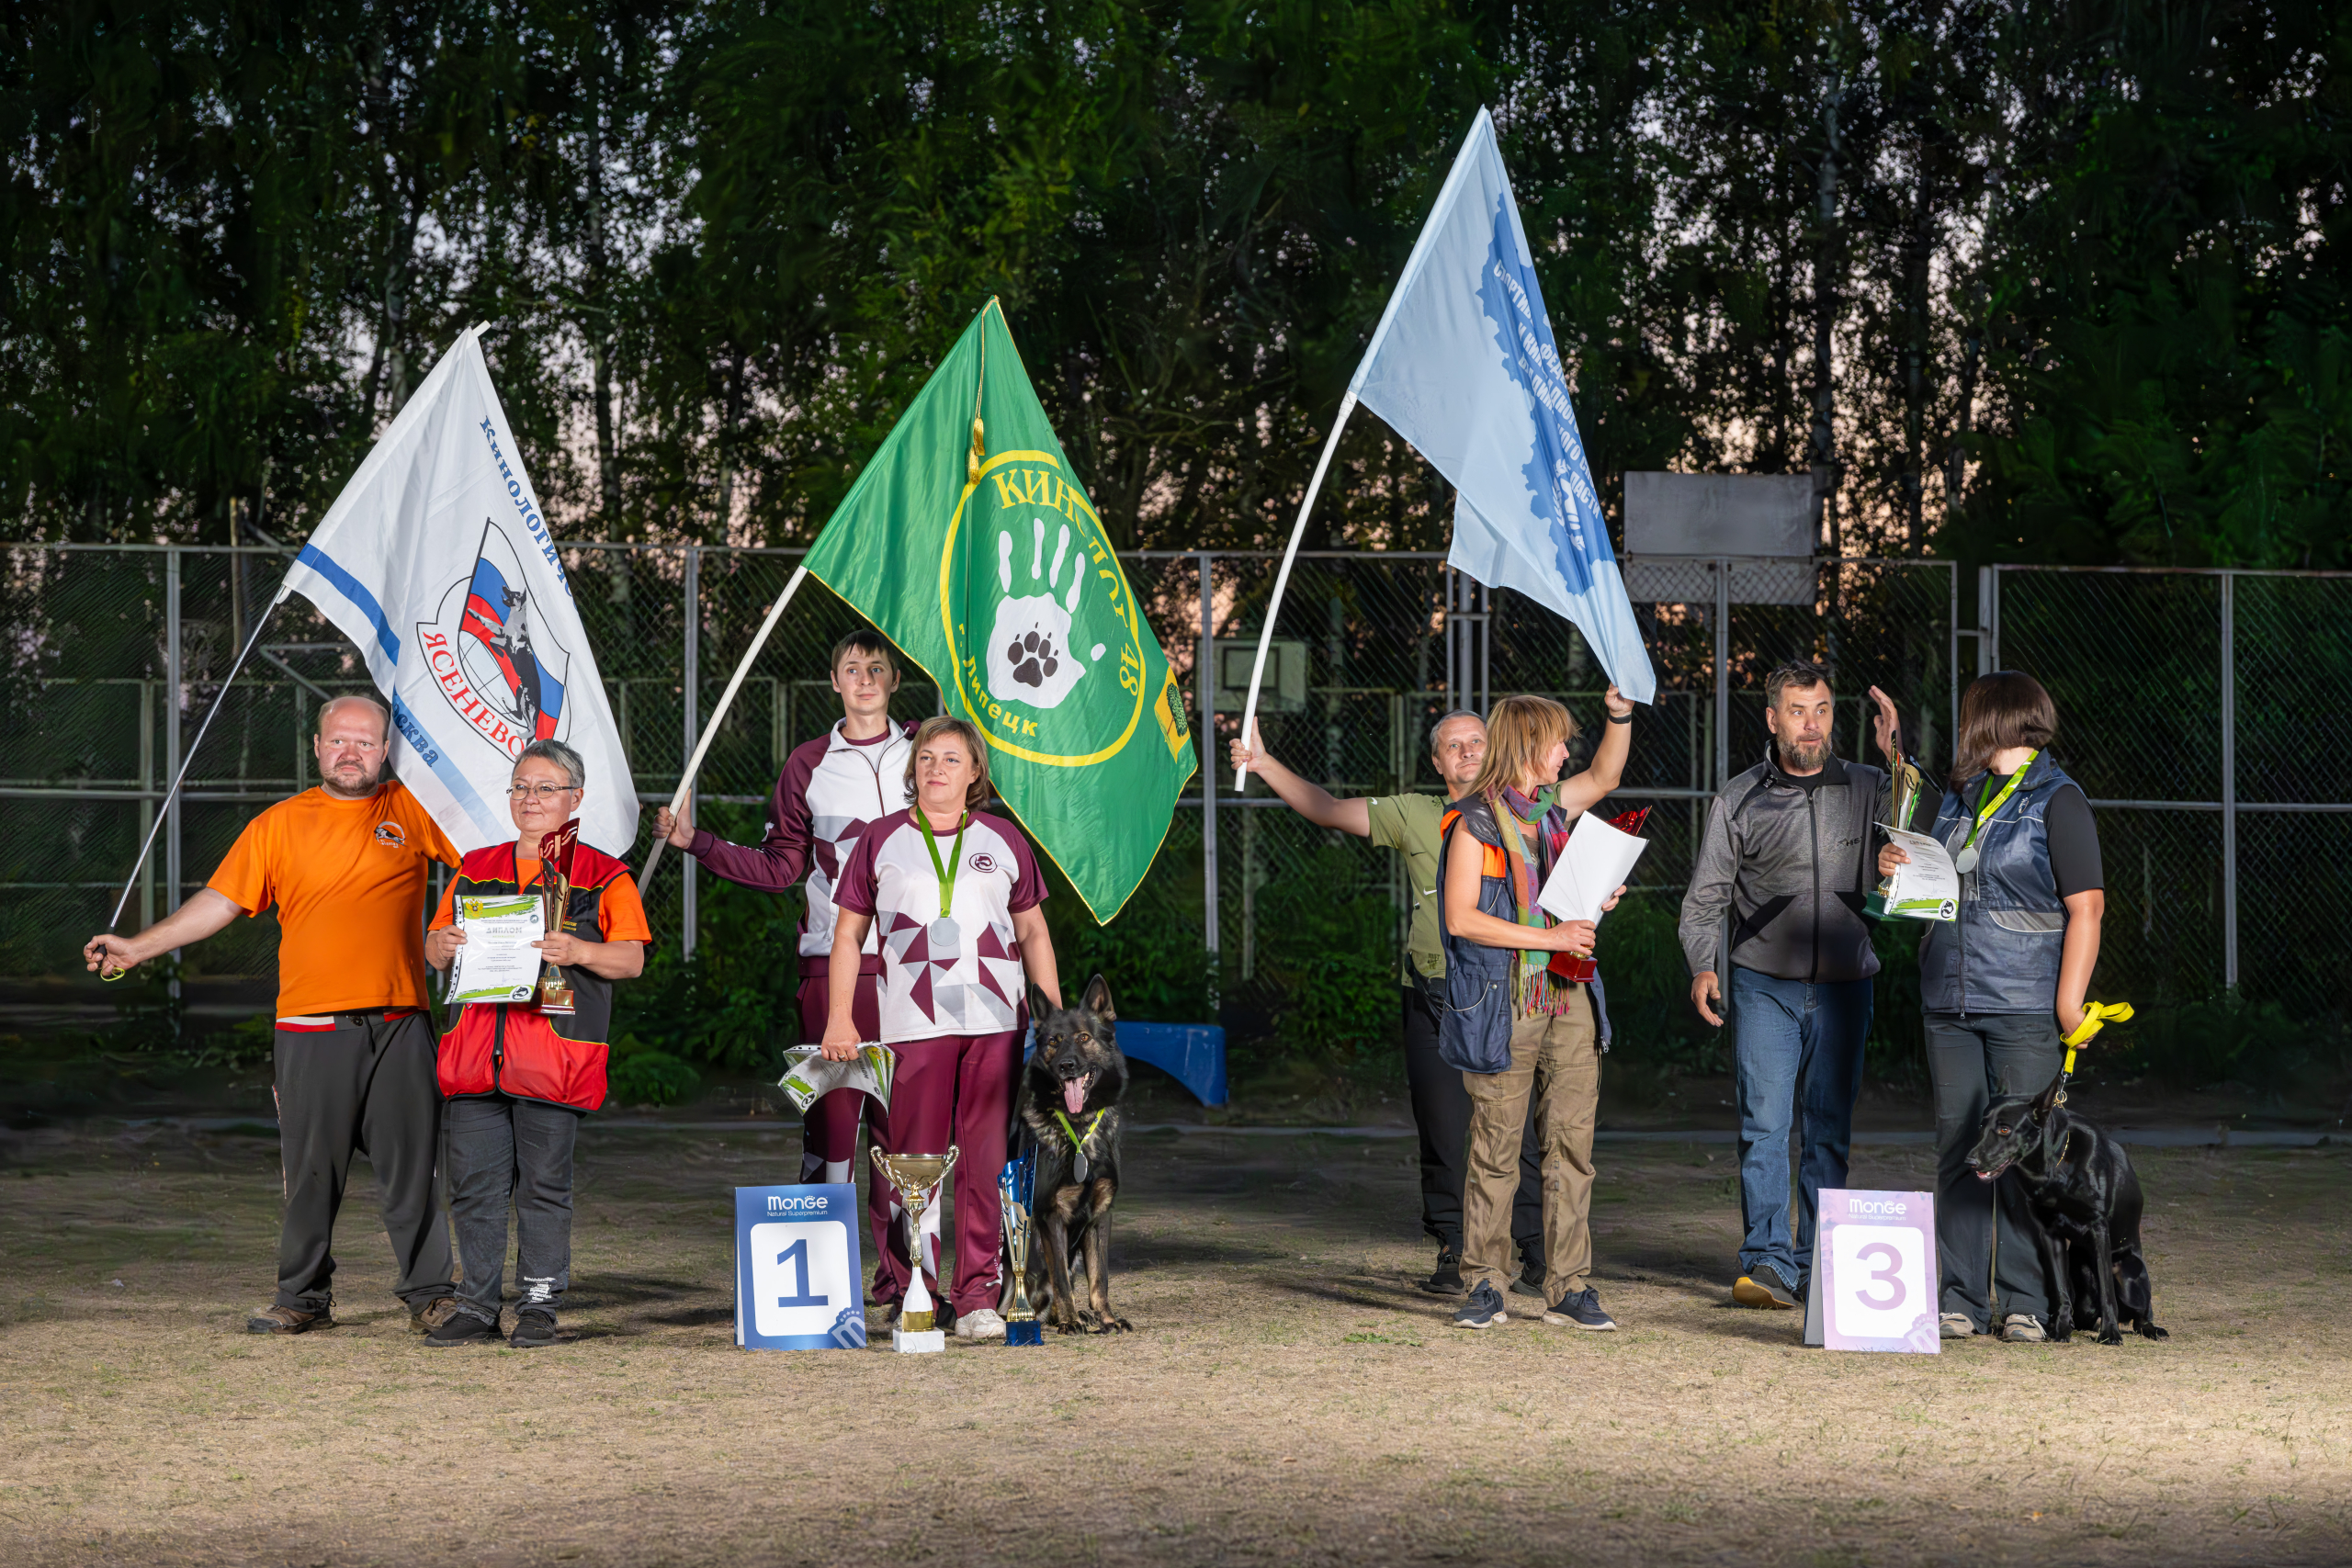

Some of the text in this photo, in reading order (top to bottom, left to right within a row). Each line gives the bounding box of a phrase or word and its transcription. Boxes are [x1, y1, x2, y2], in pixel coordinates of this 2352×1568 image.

[423, 631, 526, 760] ЯСЕНЕВО
[963, 656, 1038, 738] Липецк
[1119, 642, 1140, 697] 48
[776, 1238, 829, 1308] 1
[1855, 1242, 1907, 1311] 3
